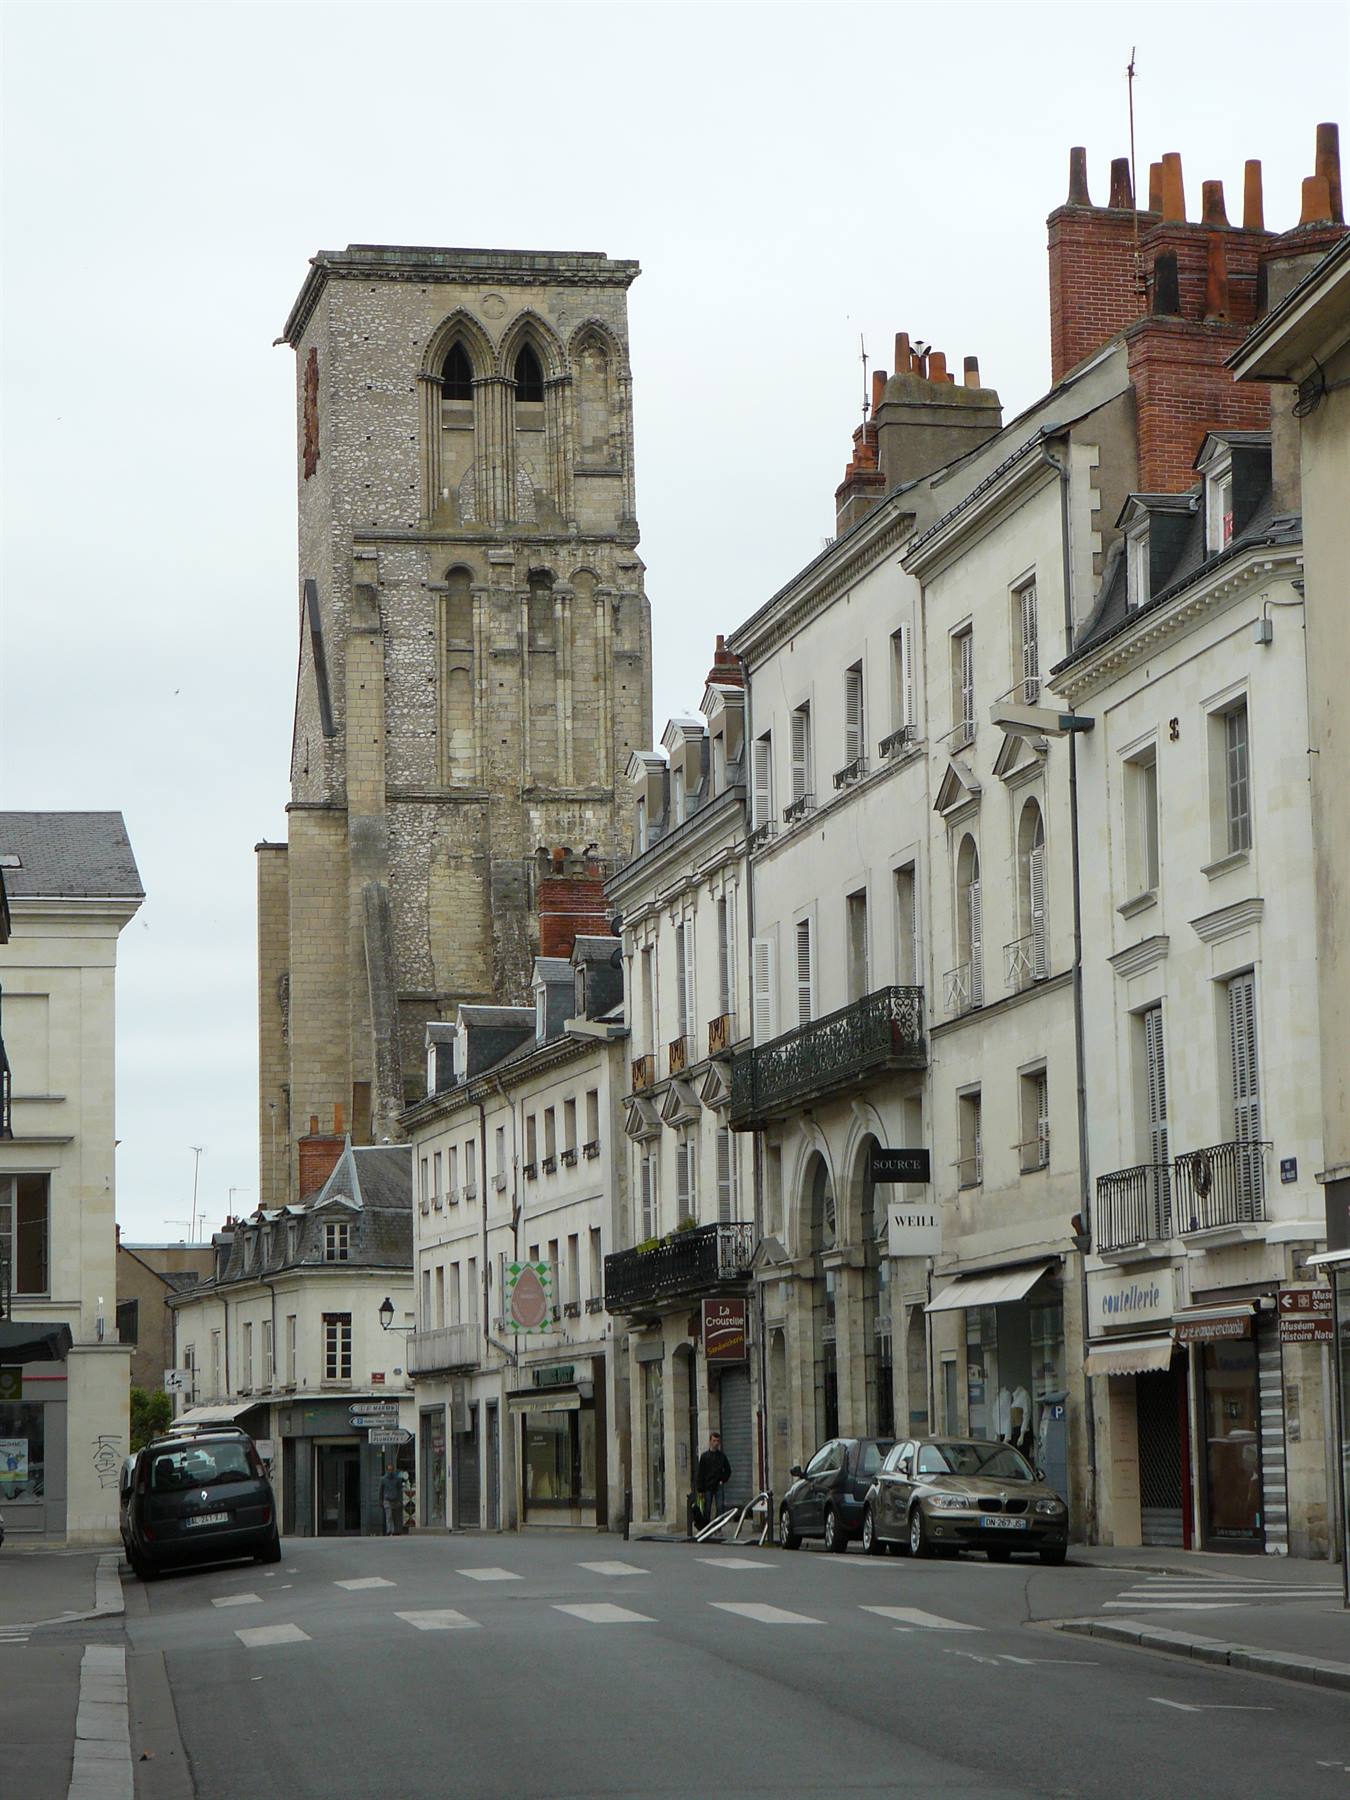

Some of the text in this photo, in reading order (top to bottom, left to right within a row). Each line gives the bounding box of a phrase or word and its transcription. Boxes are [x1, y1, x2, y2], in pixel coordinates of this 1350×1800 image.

[872, 1159, 921, 1169] SOURCE
[894, 1215, 939, 1227] WEILL
[1102, 1281, 1160, 1314] coutellerie
[719, 1305, 730, 1316] La
[1280, 1321, 1315, 1331] Muséum
[1281, 1331, 1312, 1341] Histoire
[1055, 1405, 1064, 1419] P
